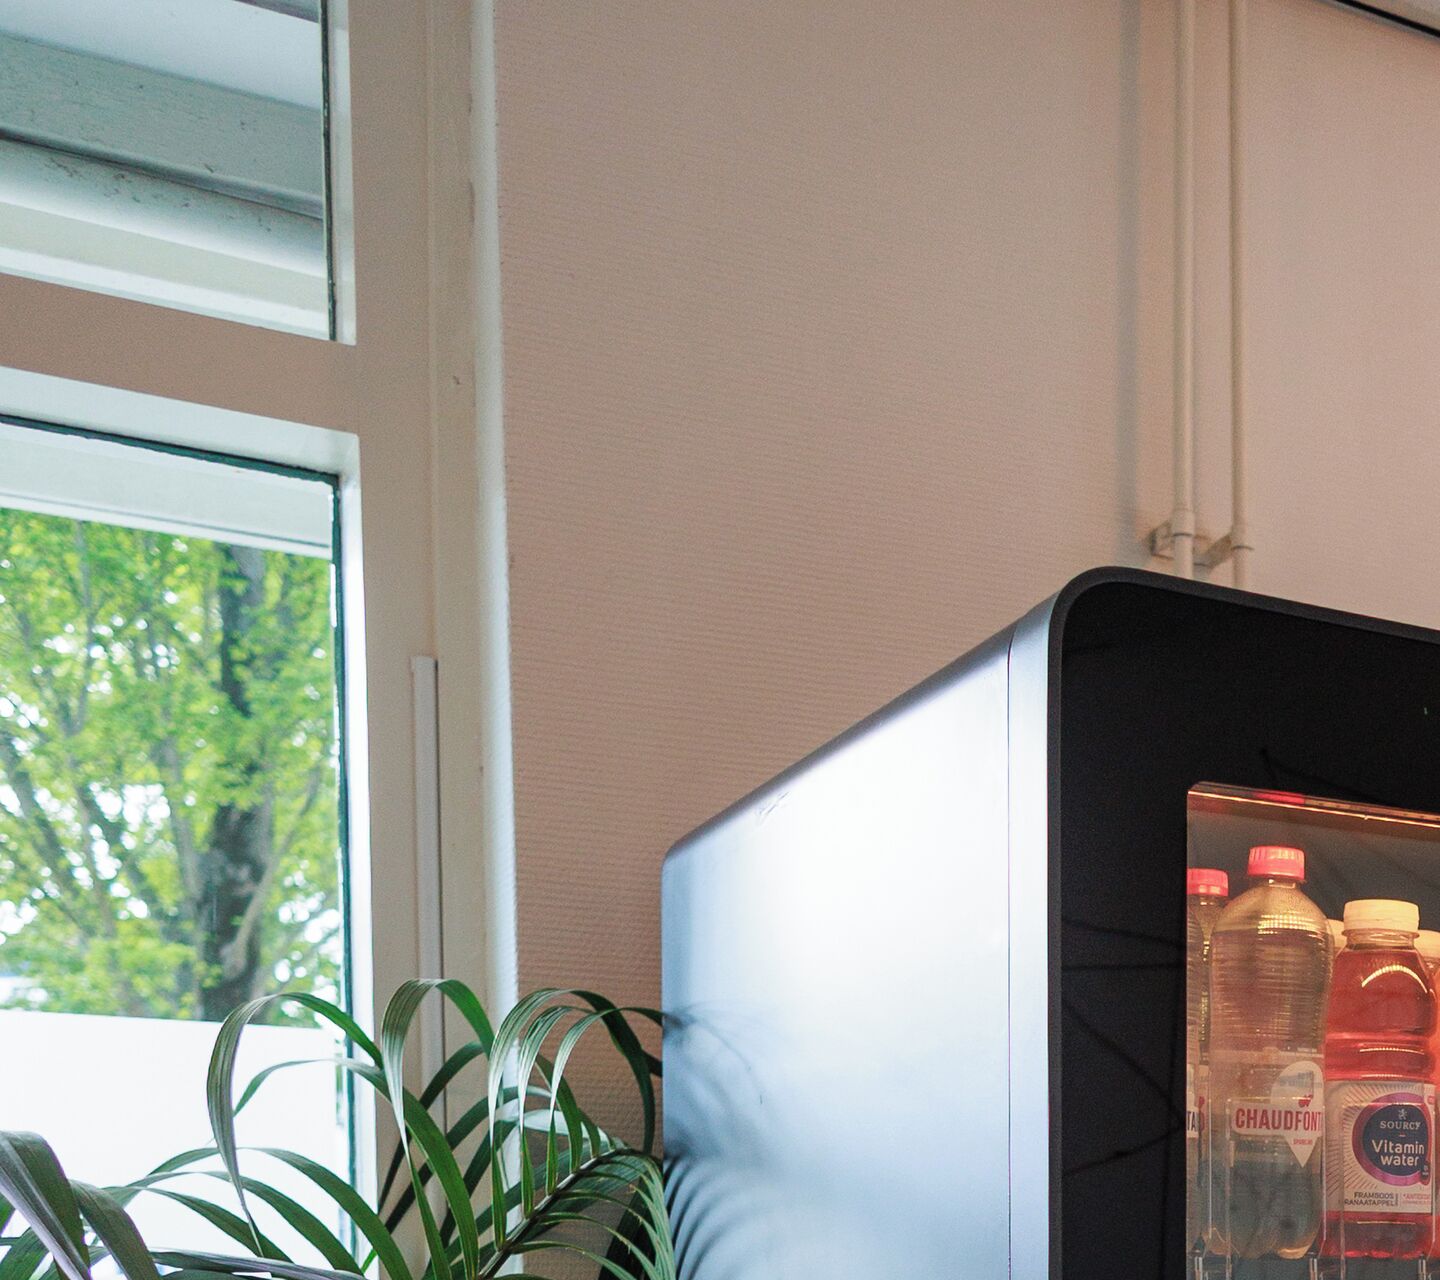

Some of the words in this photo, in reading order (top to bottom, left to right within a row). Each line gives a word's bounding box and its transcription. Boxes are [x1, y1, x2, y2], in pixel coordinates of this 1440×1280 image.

[1379, 1120, 1421, 1130] SOURCY
[1371, 1139, 1425, 1155] Vitamin
[1380, 1155, 1420, 1167] water
[1353, 1191, 1394, 1199] FRAMBOOS
